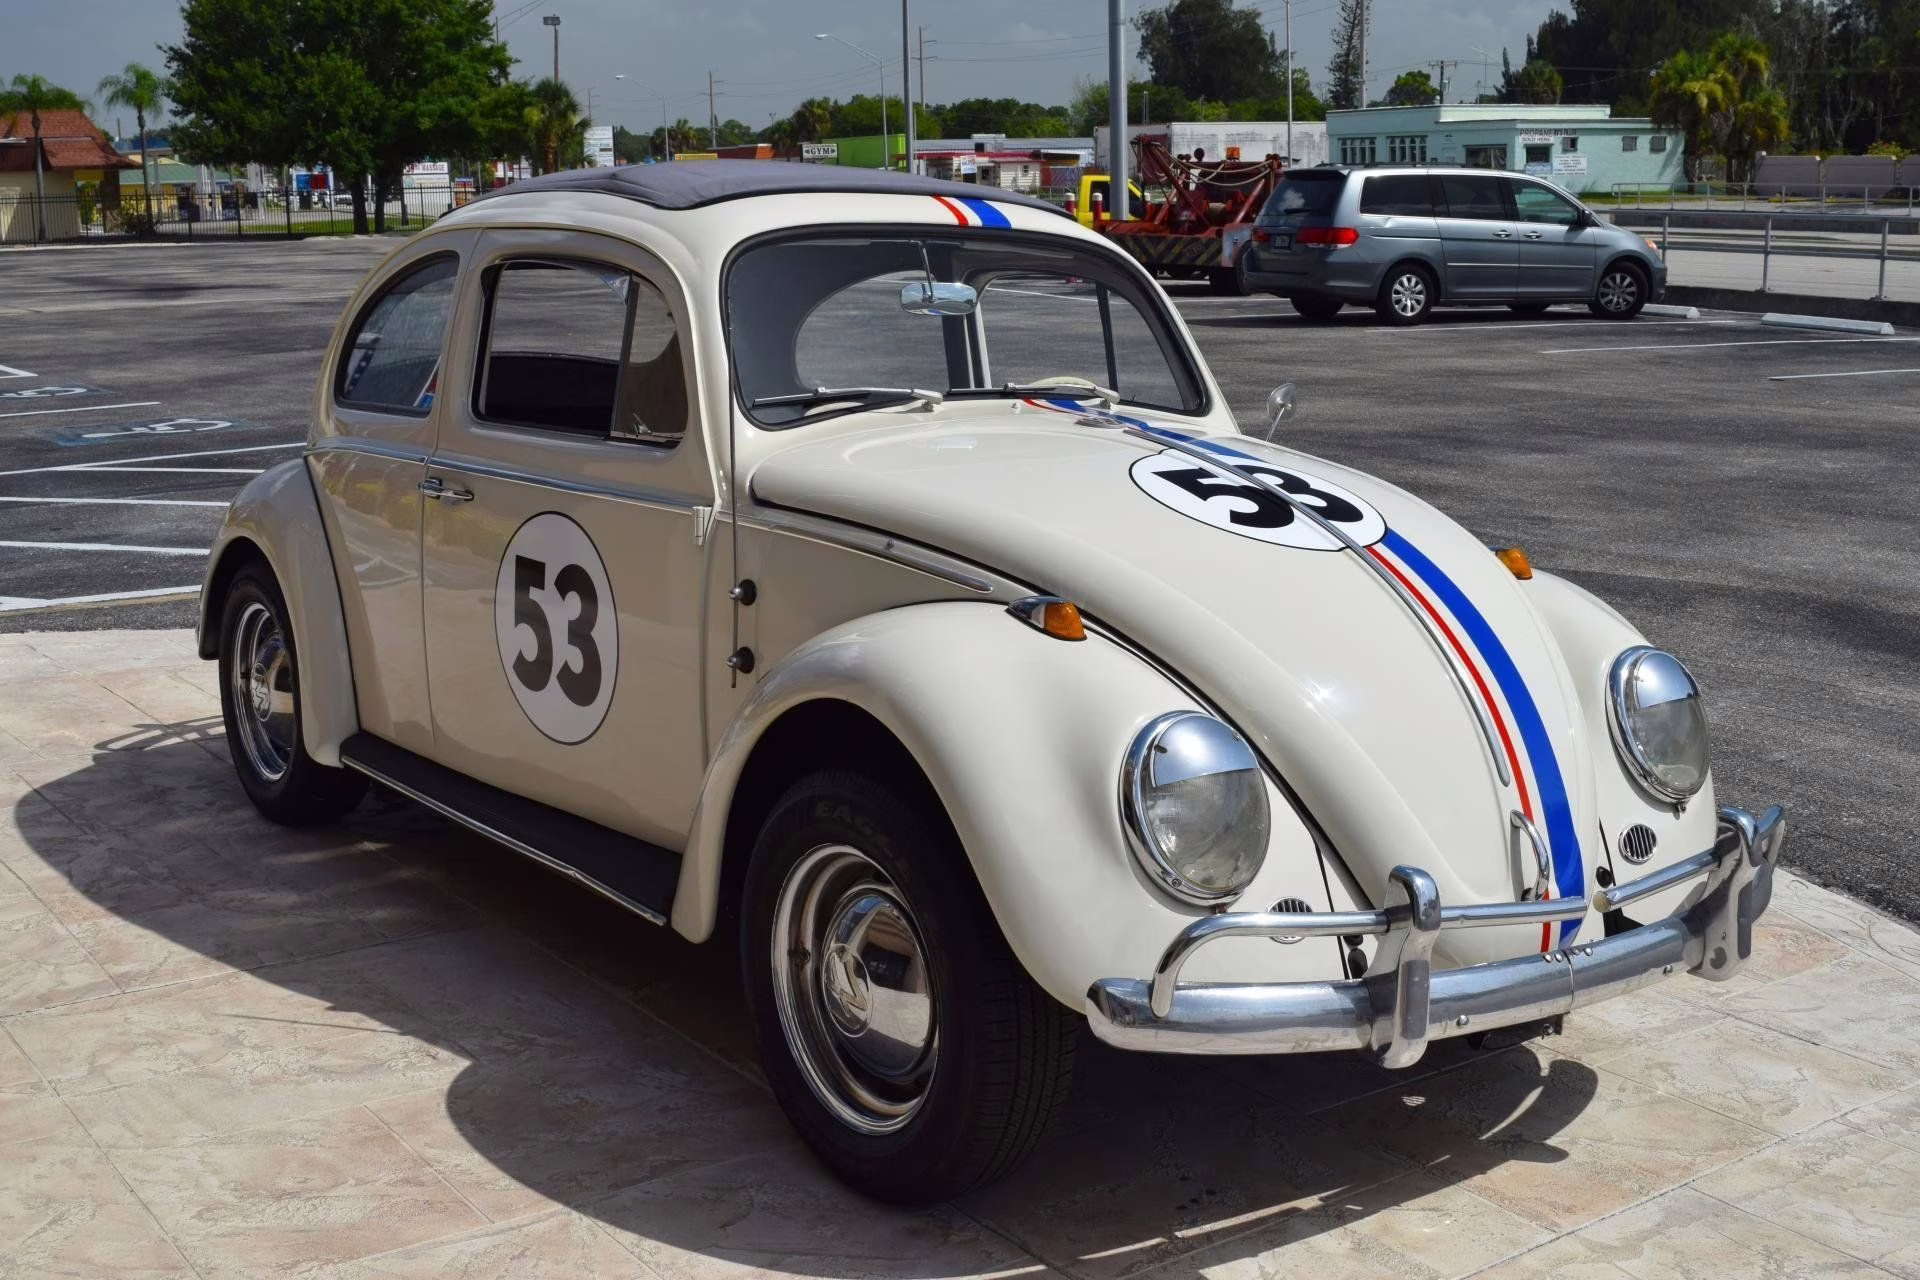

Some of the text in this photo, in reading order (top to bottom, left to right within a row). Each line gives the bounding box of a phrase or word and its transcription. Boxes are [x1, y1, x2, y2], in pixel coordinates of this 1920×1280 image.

[1520, 127, 1553, 137] PROPANE
[810, 147, 831, 155] GYM
[421, 163, 446, 172] MASSAGE
[1152, 464, 1364, 529] 53
[512, 554, 602, 707] 53
